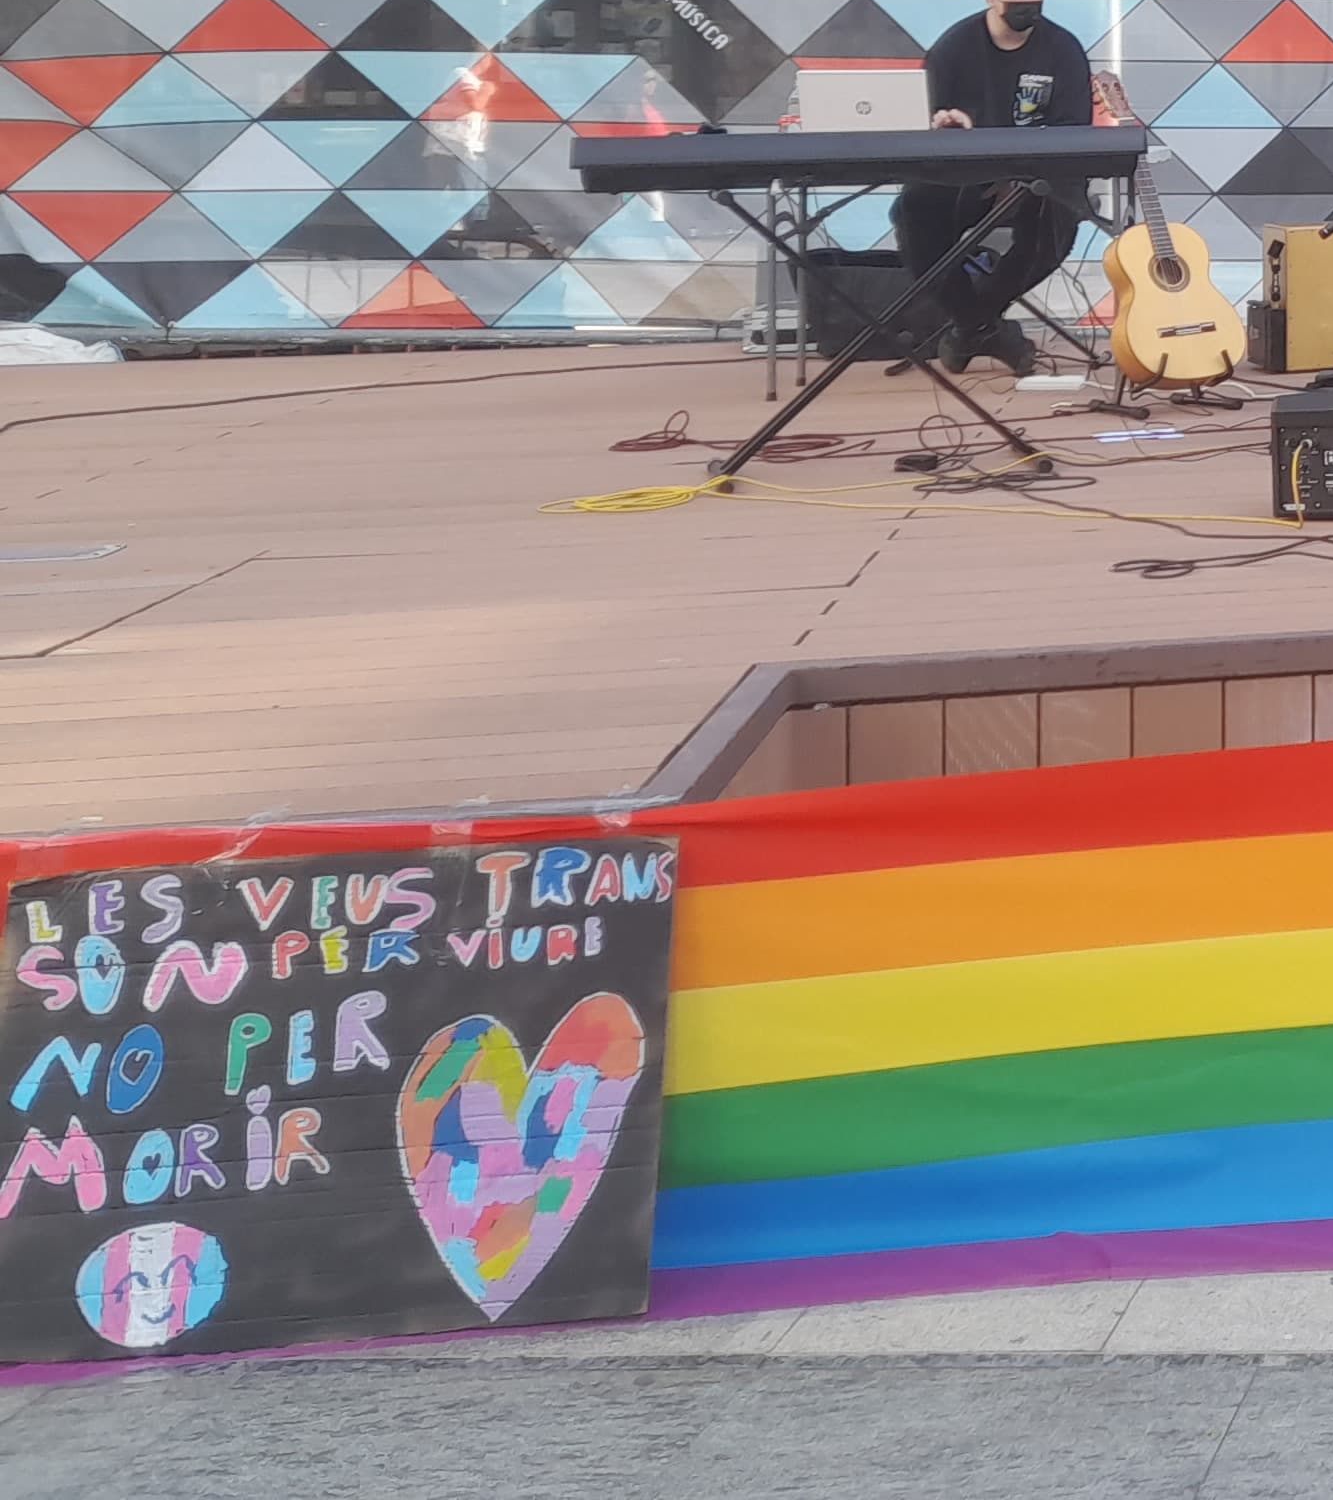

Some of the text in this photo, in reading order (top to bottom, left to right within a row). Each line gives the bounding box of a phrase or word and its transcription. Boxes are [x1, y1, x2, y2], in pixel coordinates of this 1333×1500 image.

[26, 846, 674, 943] LES VEUS TRANS
[272, 926, 421, 980] PER
[12, 990, 390, 1114] NO PER
